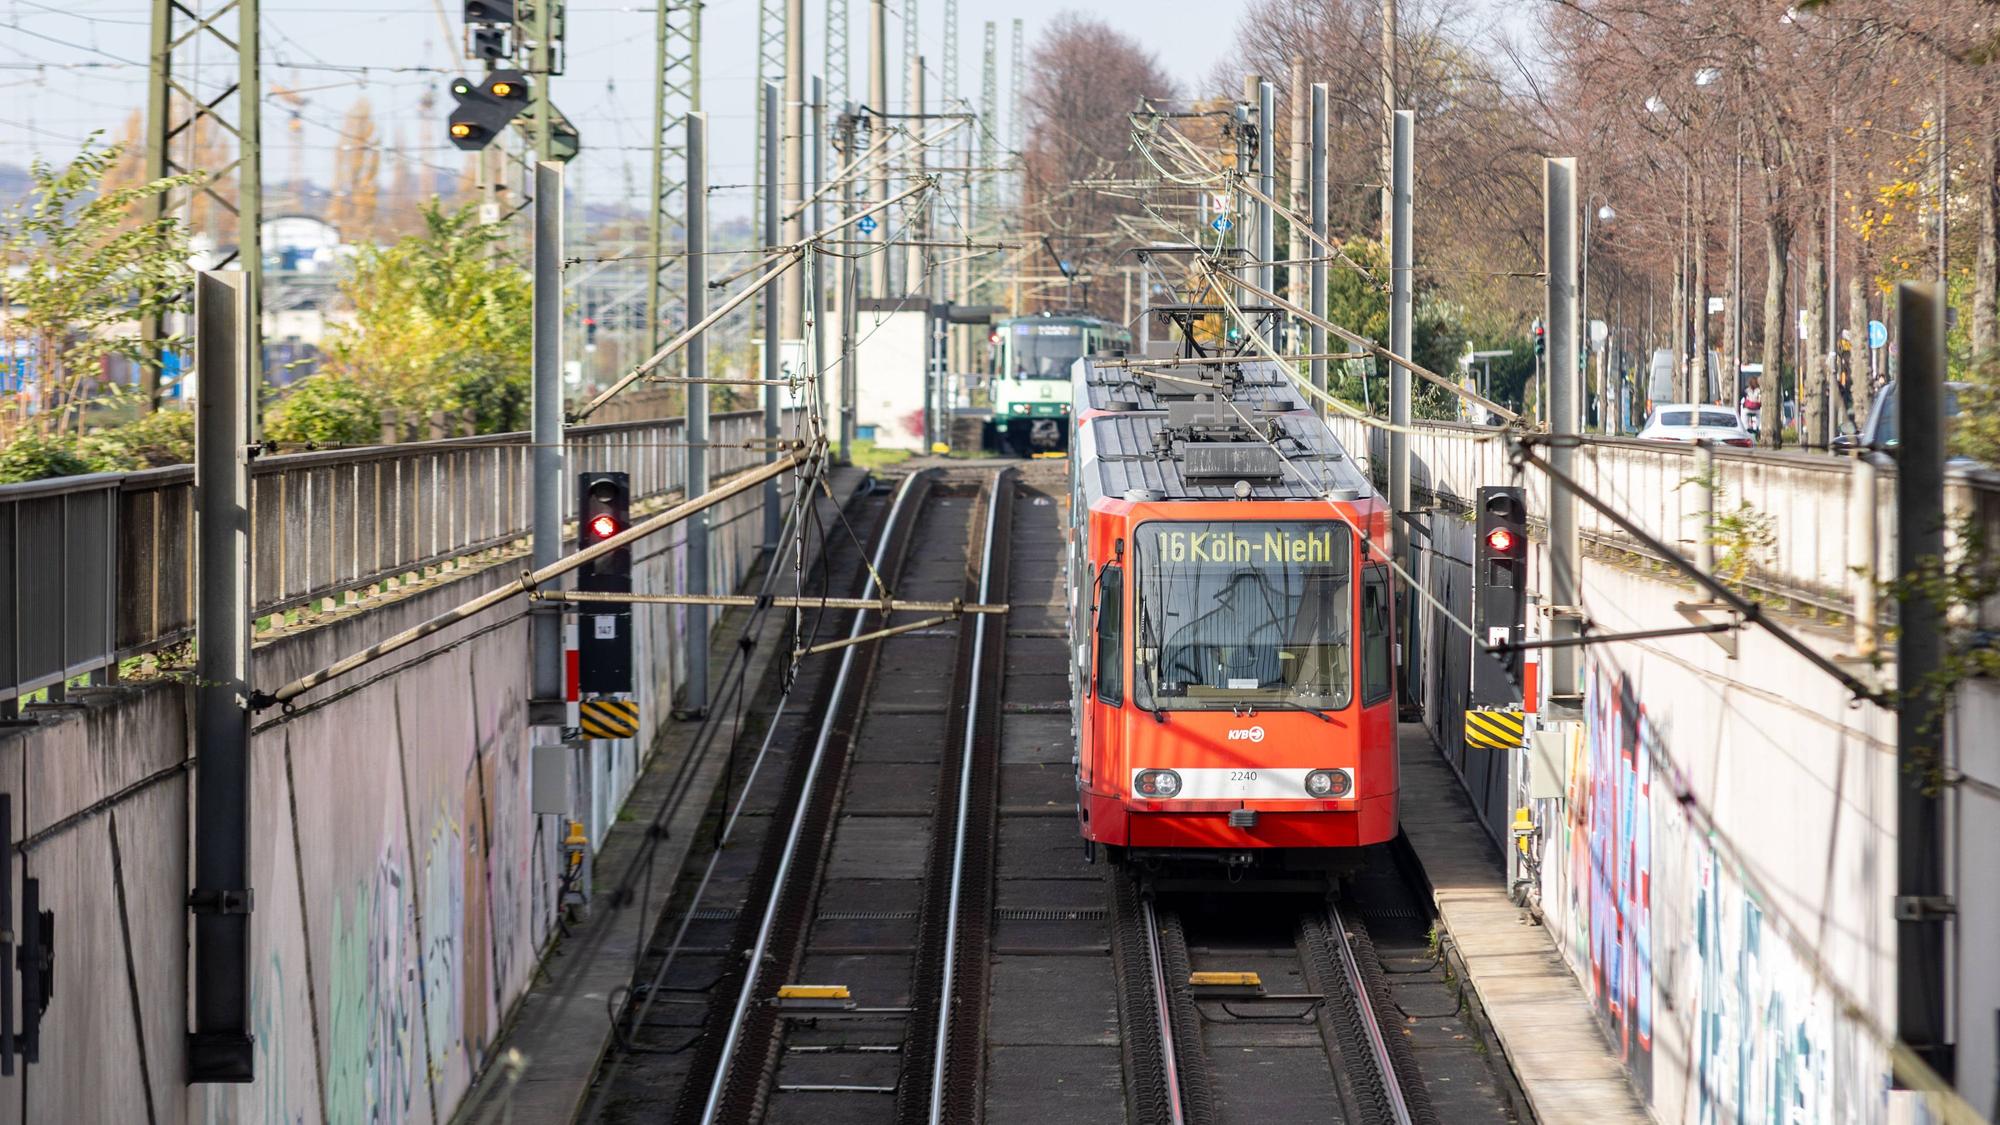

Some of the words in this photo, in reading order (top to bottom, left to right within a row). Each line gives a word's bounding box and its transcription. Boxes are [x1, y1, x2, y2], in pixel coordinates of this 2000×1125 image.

[1160, 531, 1185, 562] 16
[1191, 531, 1330, 562] Köln-Niehl
[1228, 729, 1249, 740] KVB
[1231, 771, 1257, 781] 2240
